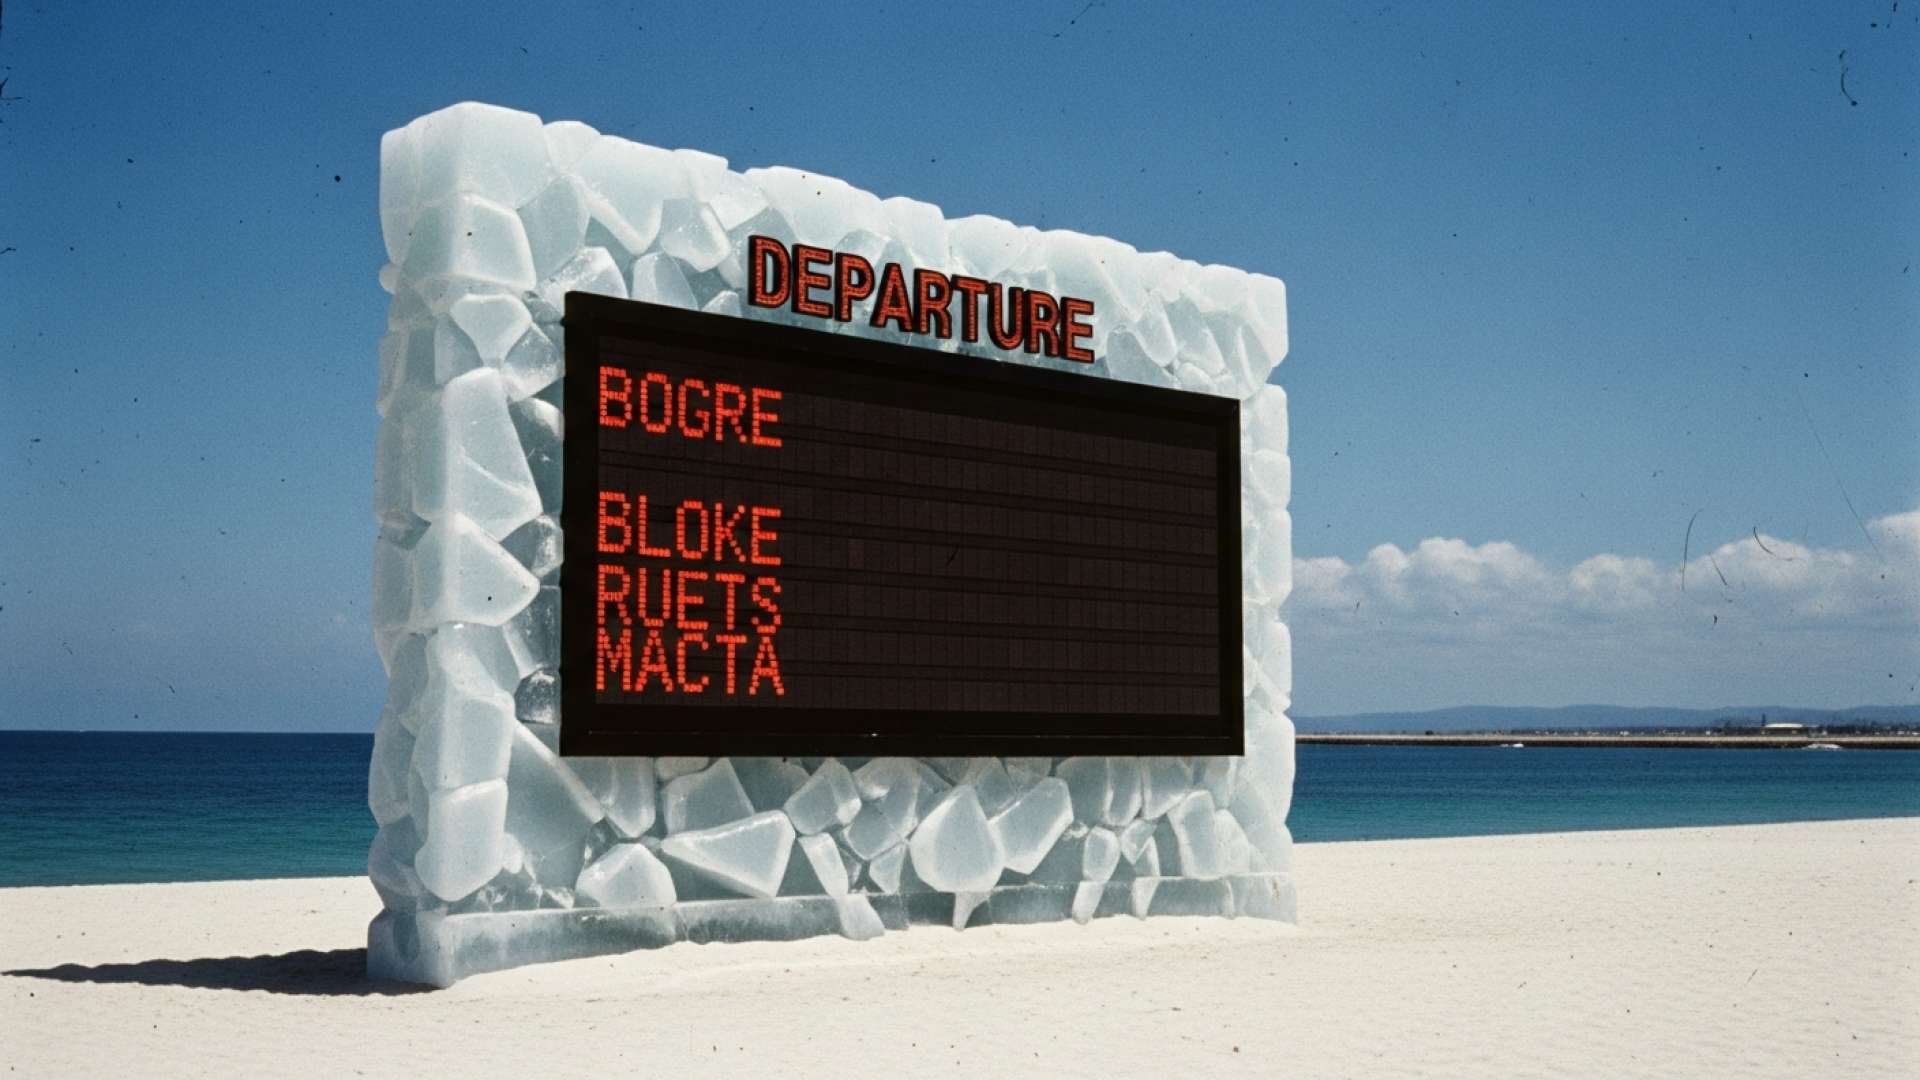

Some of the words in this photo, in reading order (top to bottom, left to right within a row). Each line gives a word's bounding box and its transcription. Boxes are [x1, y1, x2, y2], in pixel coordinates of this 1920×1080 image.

[748, 235, 1095, 363] DEPARTURE
[599, 366, 782, 447] BOGRE
[598, 491, 782, 565] BLOKE
[597, 564, 782, 634] RUETS
[596, 627, 785, 696] MACTA
